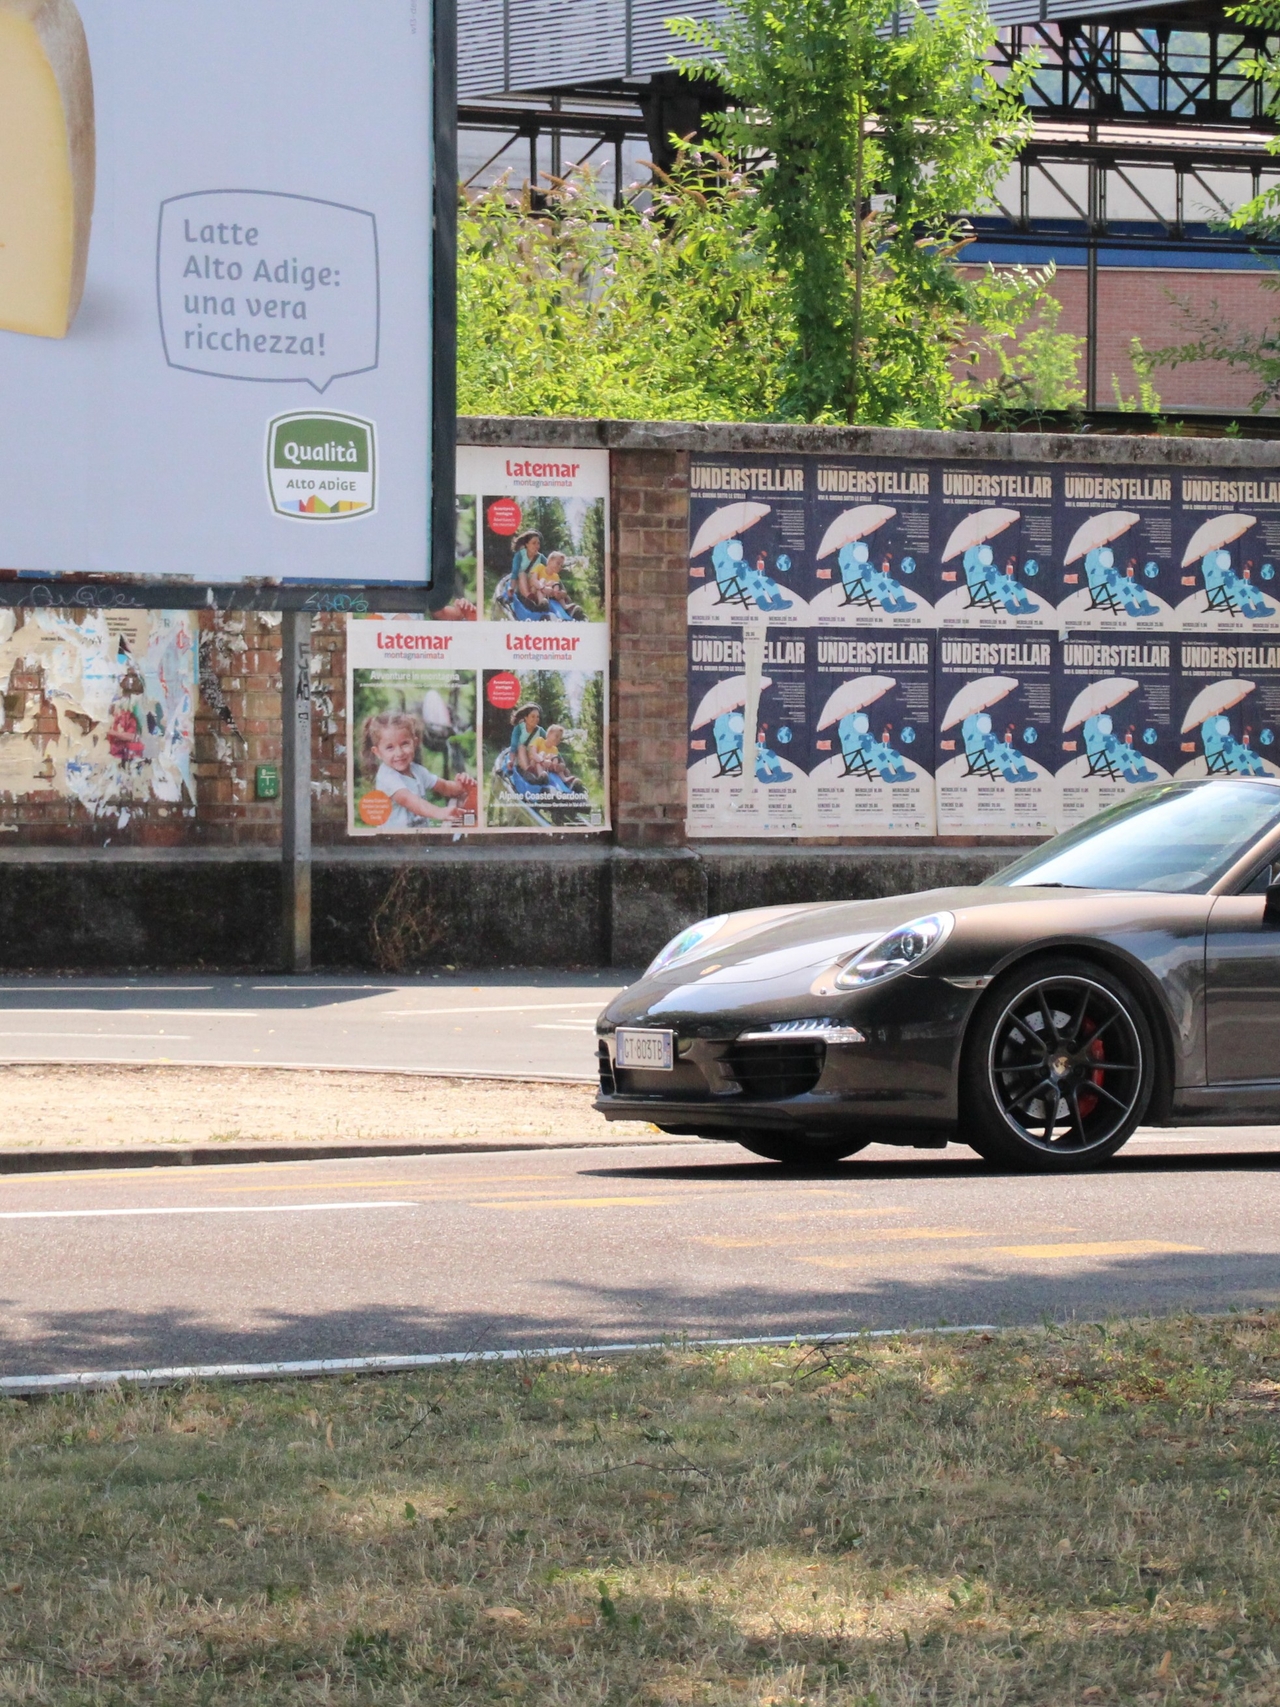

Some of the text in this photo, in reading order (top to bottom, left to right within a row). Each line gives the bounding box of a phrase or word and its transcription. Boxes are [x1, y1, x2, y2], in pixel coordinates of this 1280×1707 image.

[185, 219, 259, 246] Latte
[183, 256, 341, 291] Alto Adige:
[185, 294, 307, 319] una vera
[185, 324, 325, 356] ricchezza!
[284, 442, 358, 463] Qualità
[507, 460, 579, 478] latemar
[691, 467, 804, 491] UNDERSTELLAR
[818, 470, 929, 494] UNDERSTELLAR
[943, 474, 1052, 498] UNDERSTELLAR
[1065, 477, 1171, 500] UNDERSTELLAR
[378, 632, 452, 649] latemar
[507, 633, 579, 651] latemar
[384, 651, 444, 661] montagnanimata
[513, 652, 572, 662] montagnanimata
[818, 642, 928, 664] UNDERSTELLAR
[942, 643, 1050, 665] UNDERSTELLAR
[1064, 645, 1170, 667] UNDERSTELLAR
[371, 671, 459, 682] Avventure in montagna
[499, 791, 524, 802] Alpine
[525, 791, 555, 800] Coaster
